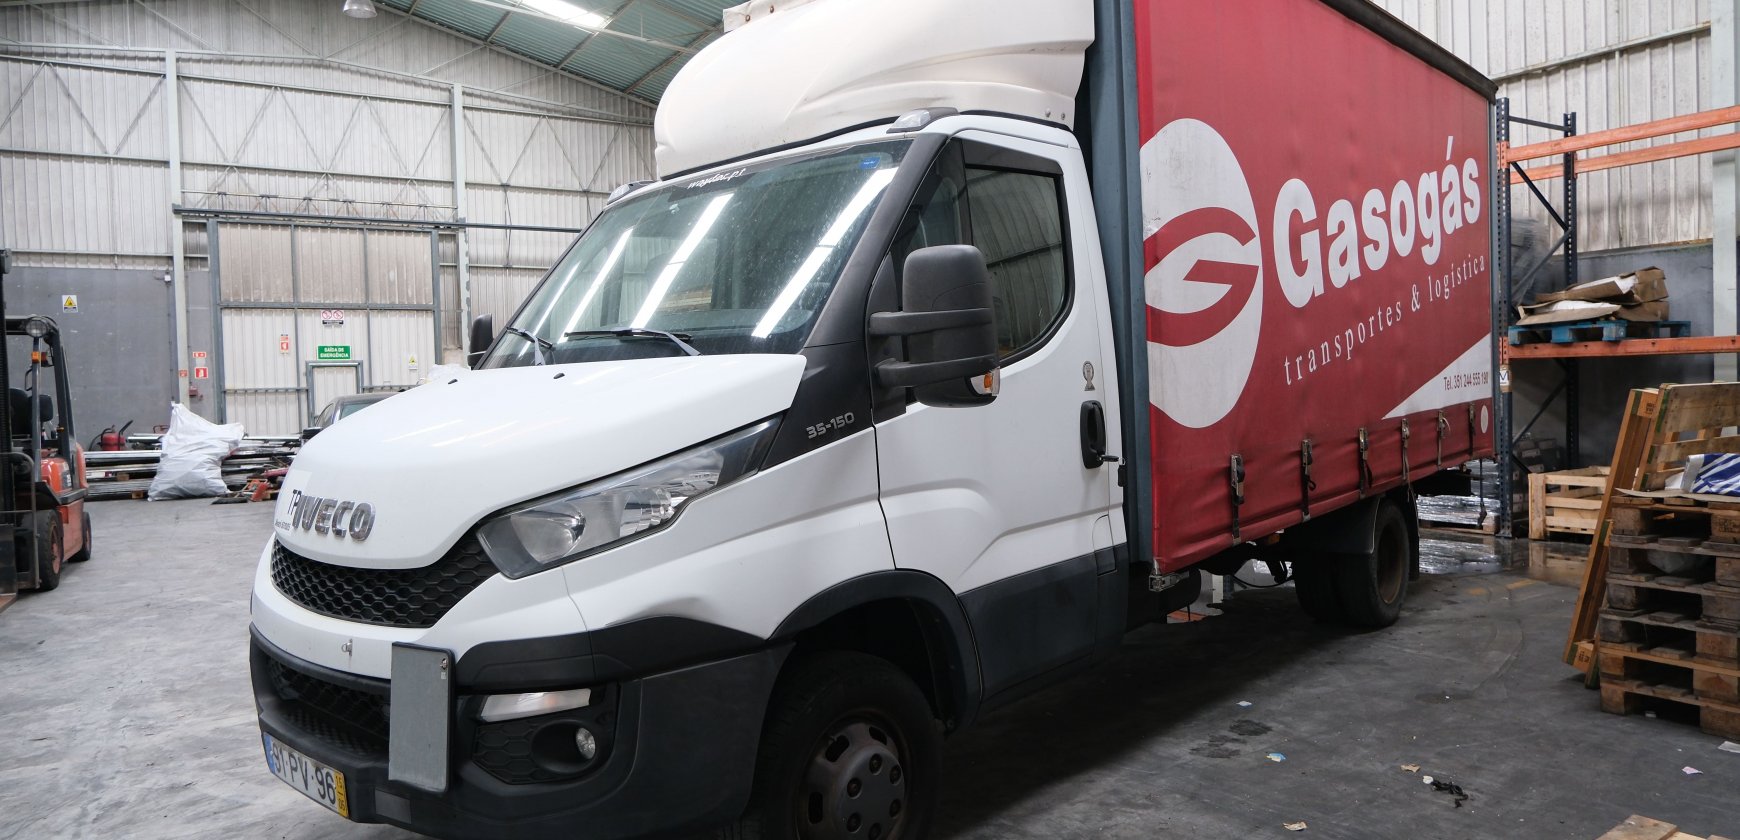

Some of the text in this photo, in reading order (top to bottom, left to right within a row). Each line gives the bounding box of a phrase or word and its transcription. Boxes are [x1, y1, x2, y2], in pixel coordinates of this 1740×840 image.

[1273, 135, 1480, 308] Gasogás
[1284, 254, 1485, 385] transportes & logística
[1443, 377, 1453, 391] Tel.
[1454, 375, 1463, 389] 351
[1464, 373, 1472, 387] 244
[806, 412, 855, 439] 35-150
[292, 495, 376, 541] IVECO
